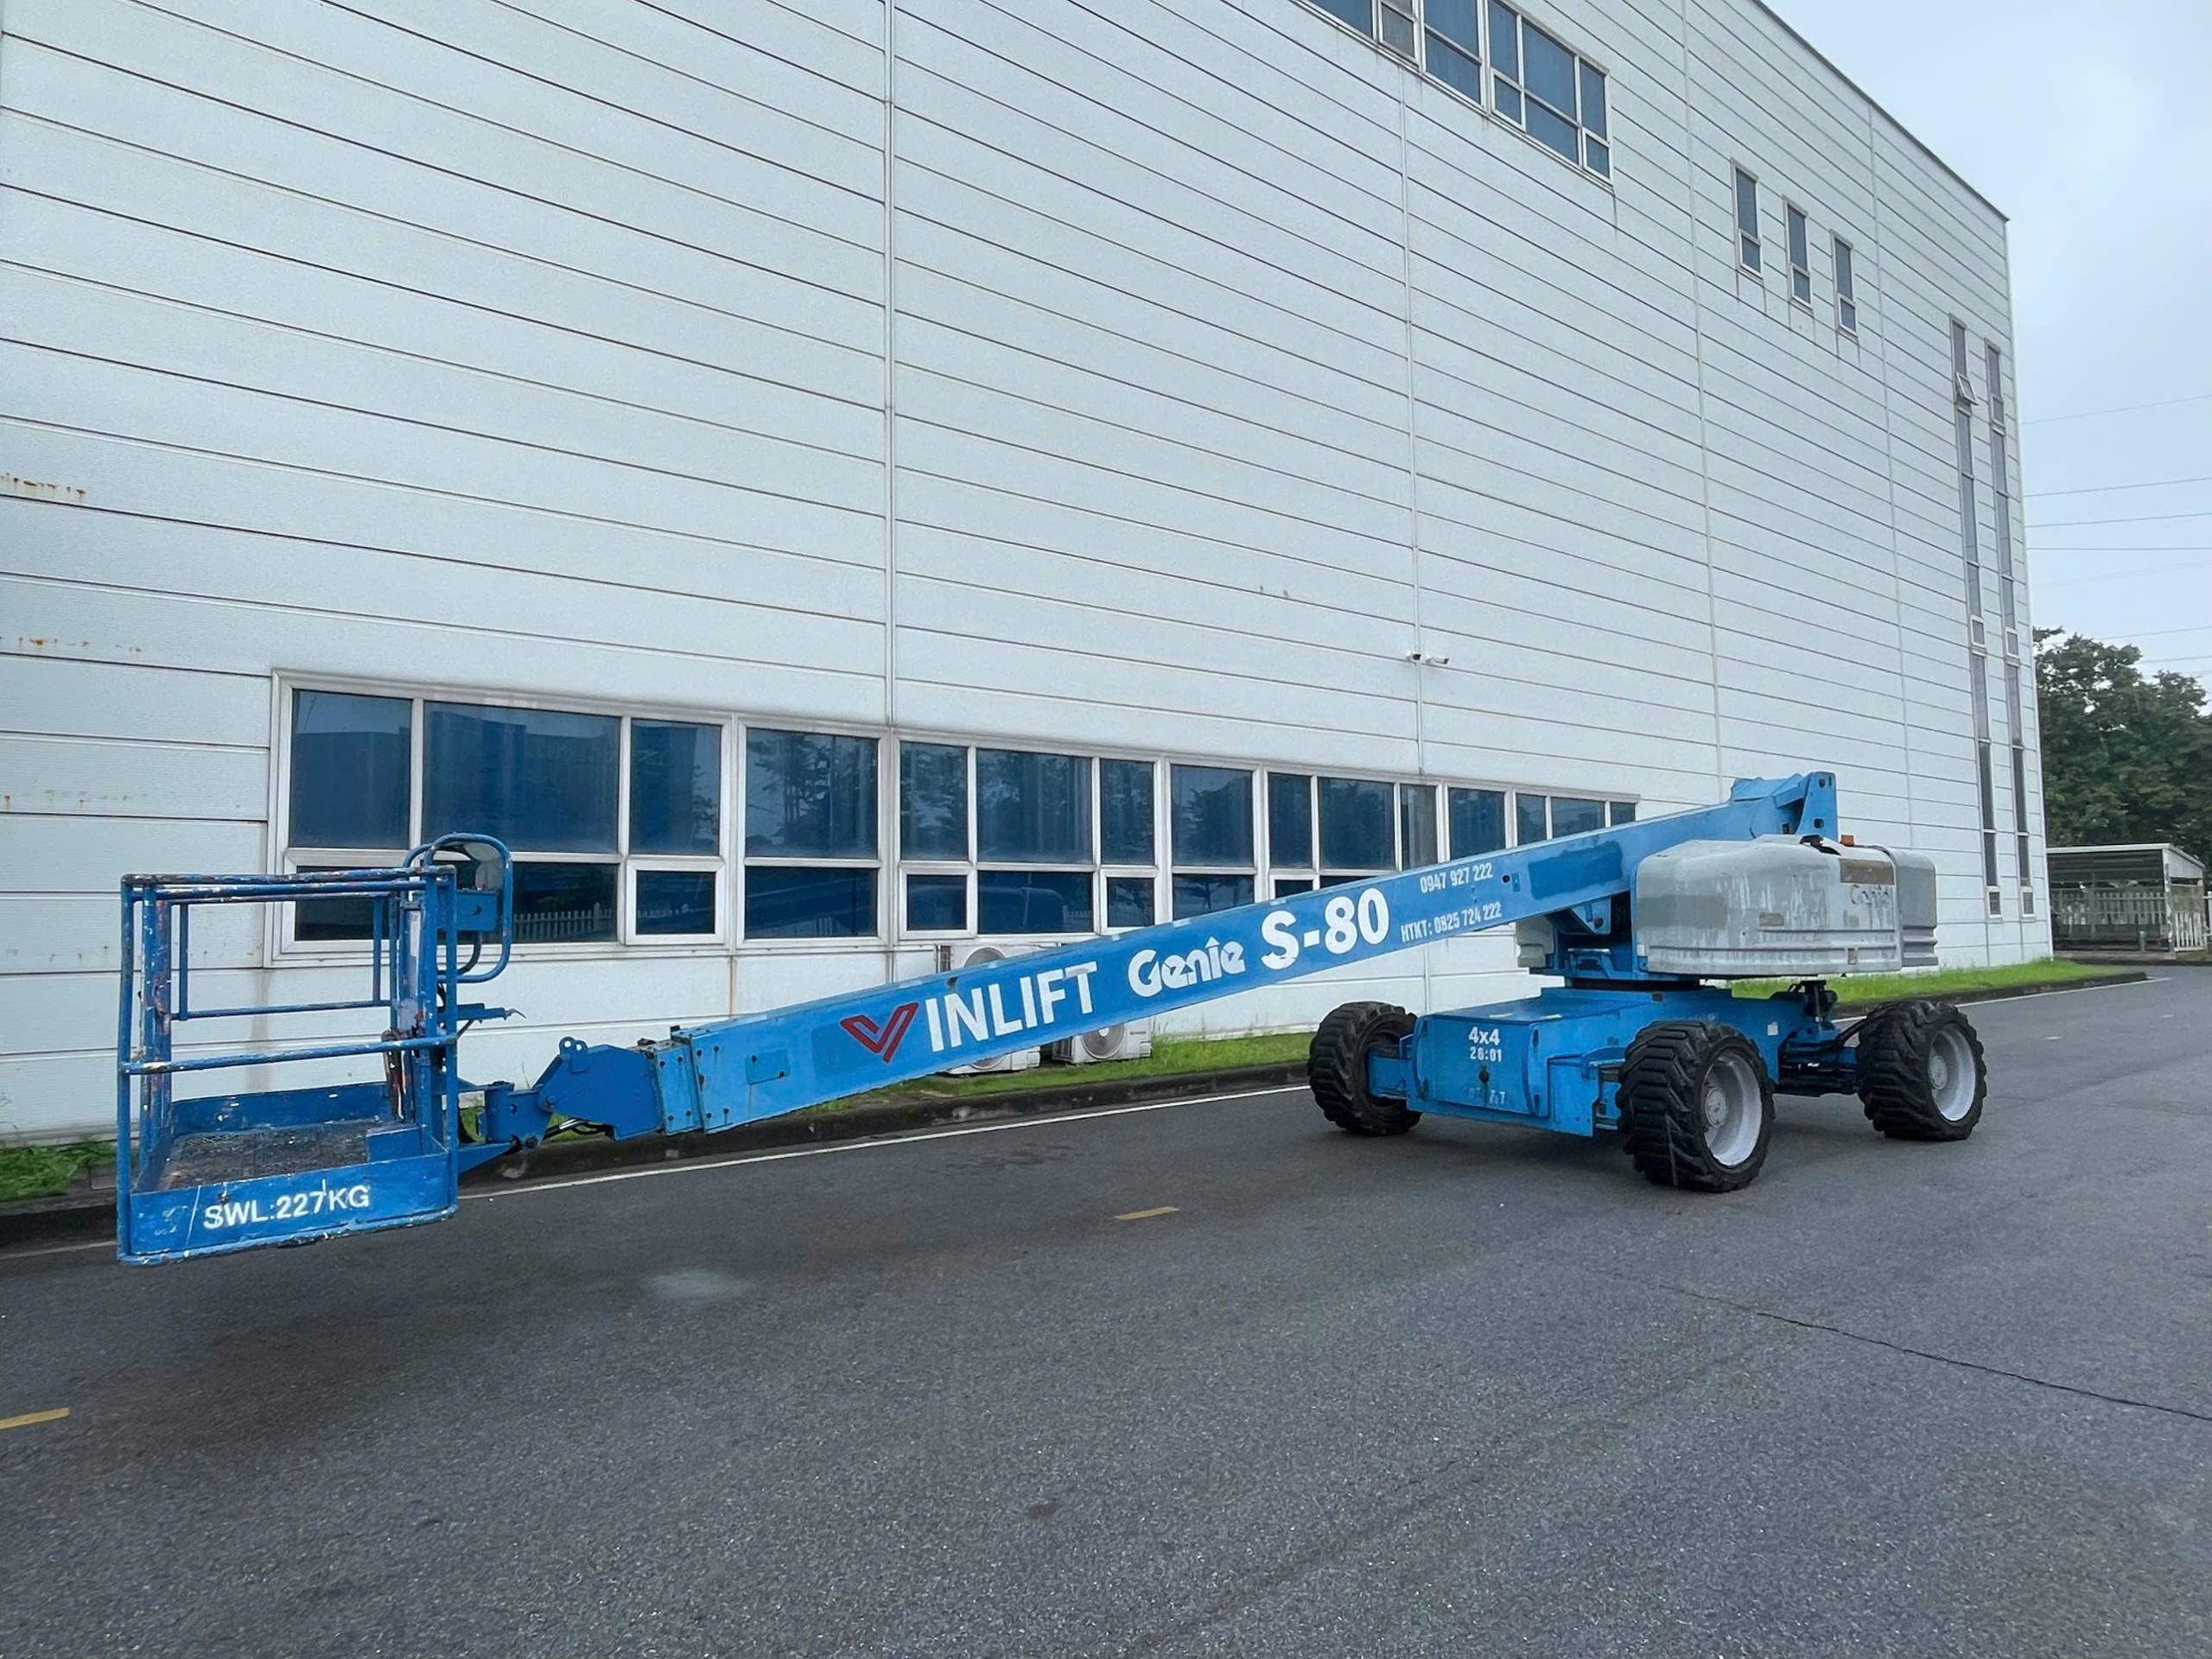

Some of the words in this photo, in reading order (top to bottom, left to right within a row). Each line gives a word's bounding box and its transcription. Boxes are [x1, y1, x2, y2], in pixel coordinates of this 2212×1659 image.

[1420, 872, 1446, 893] 0947
[1450, 868, 1470, 887] 927
[1472, 862, 1493, 881] 222
[1401, 919, 1433, 943] HTKT:
[1433, 912, 1460, 933] 0825
[1460, 907, 1481, 926] 724
[1482, 902, 1502, 920] 222
[1128, 936, 1246, 997] Genie
[1261, 887, 1389, 969] S-80
[1468, 1026, 1501, 1046] 4x4
